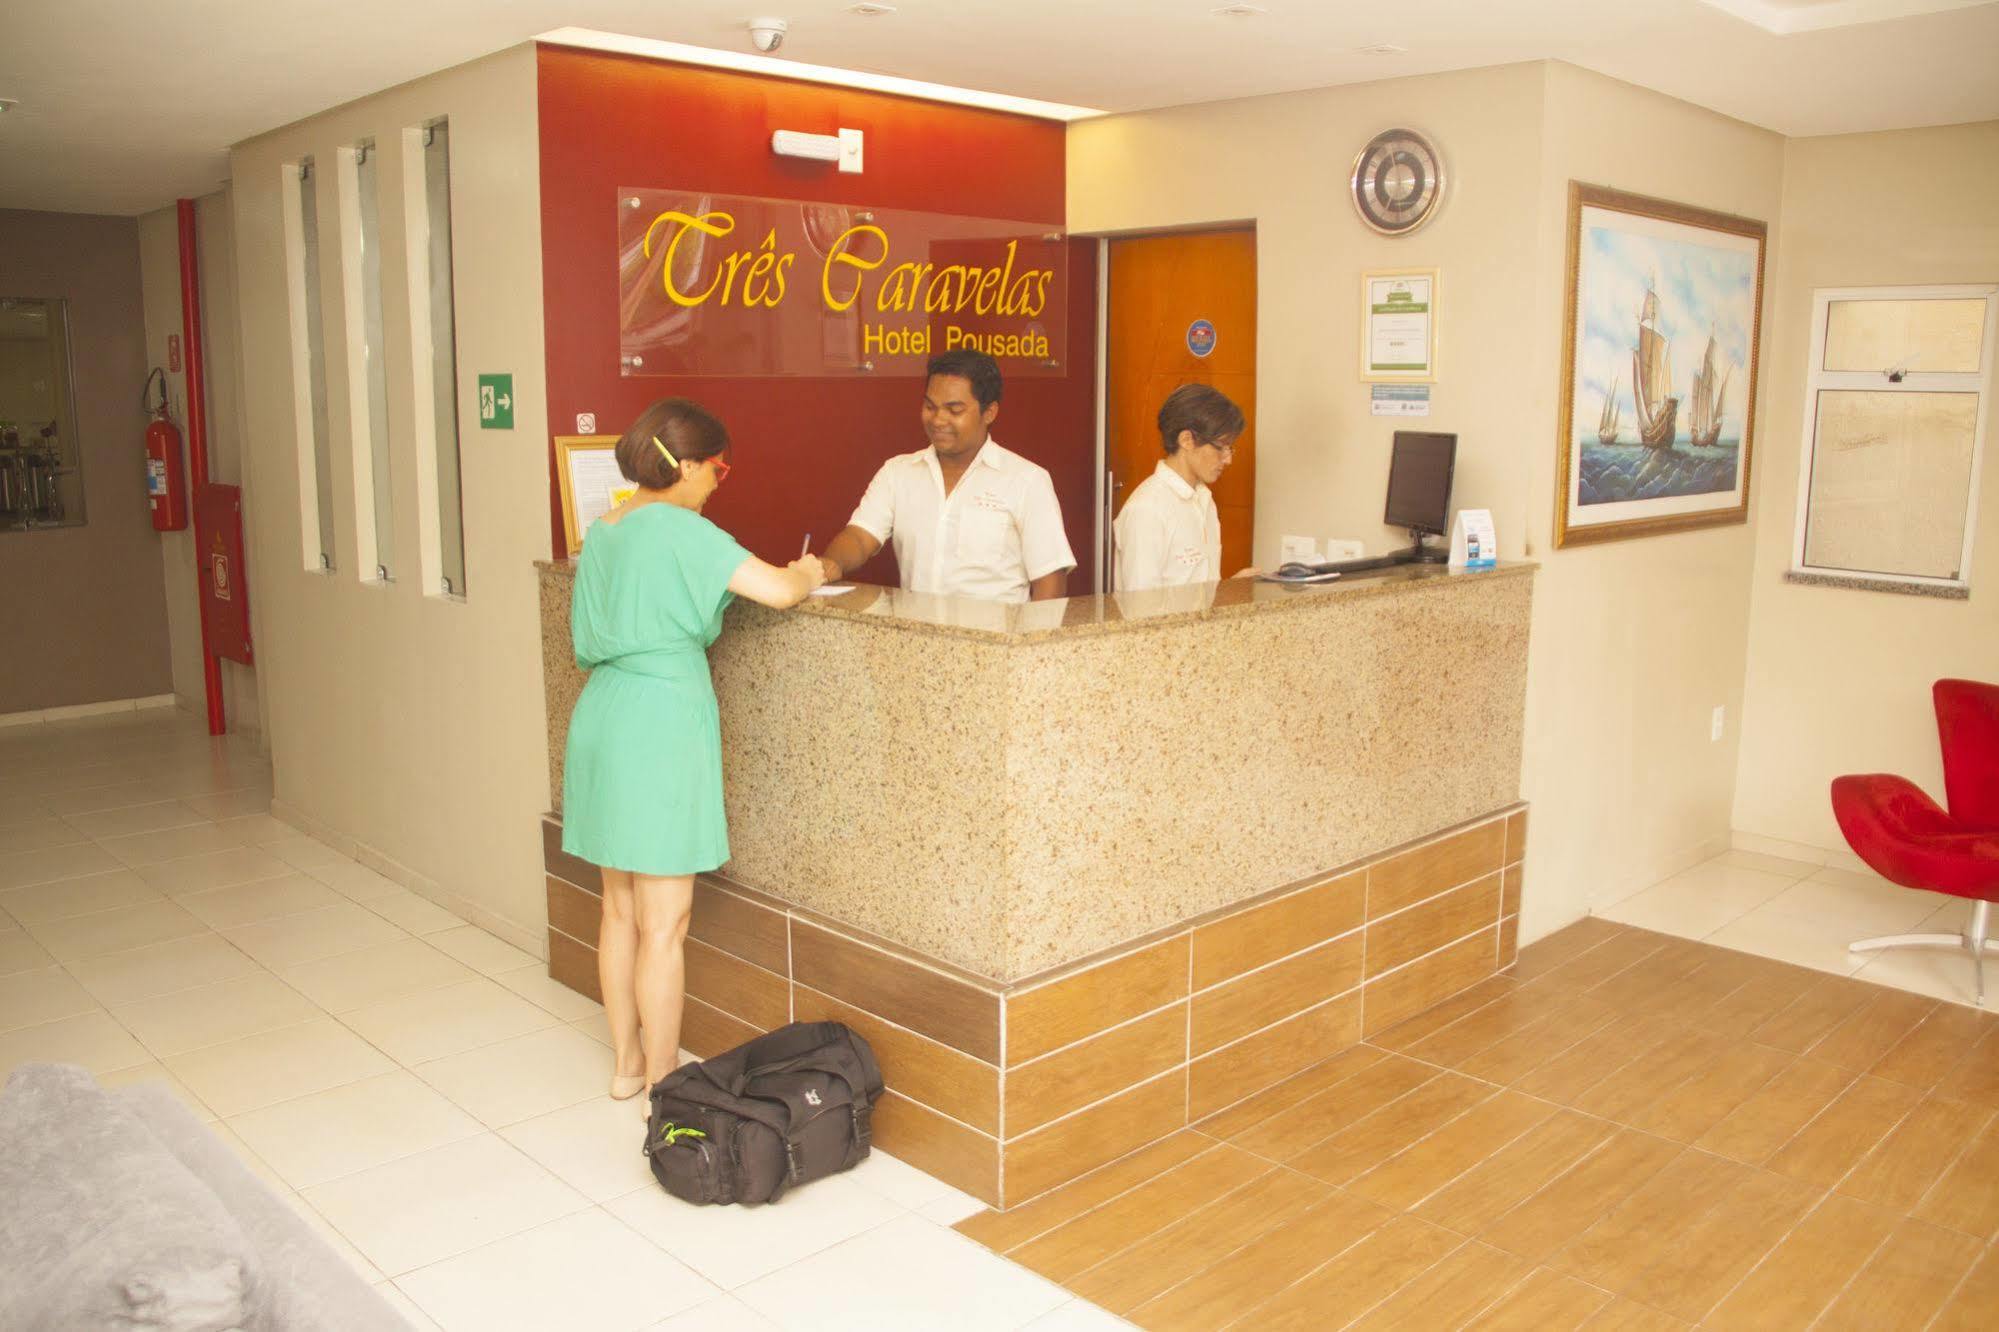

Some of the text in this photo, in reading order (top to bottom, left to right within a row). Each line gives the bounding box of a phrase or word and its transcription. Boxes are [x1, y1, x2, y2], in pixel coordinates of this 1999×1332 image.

[643, 210, 1054, 318] Três Caravelas
[864, 324, 1049, 357] Hotel Pousada
